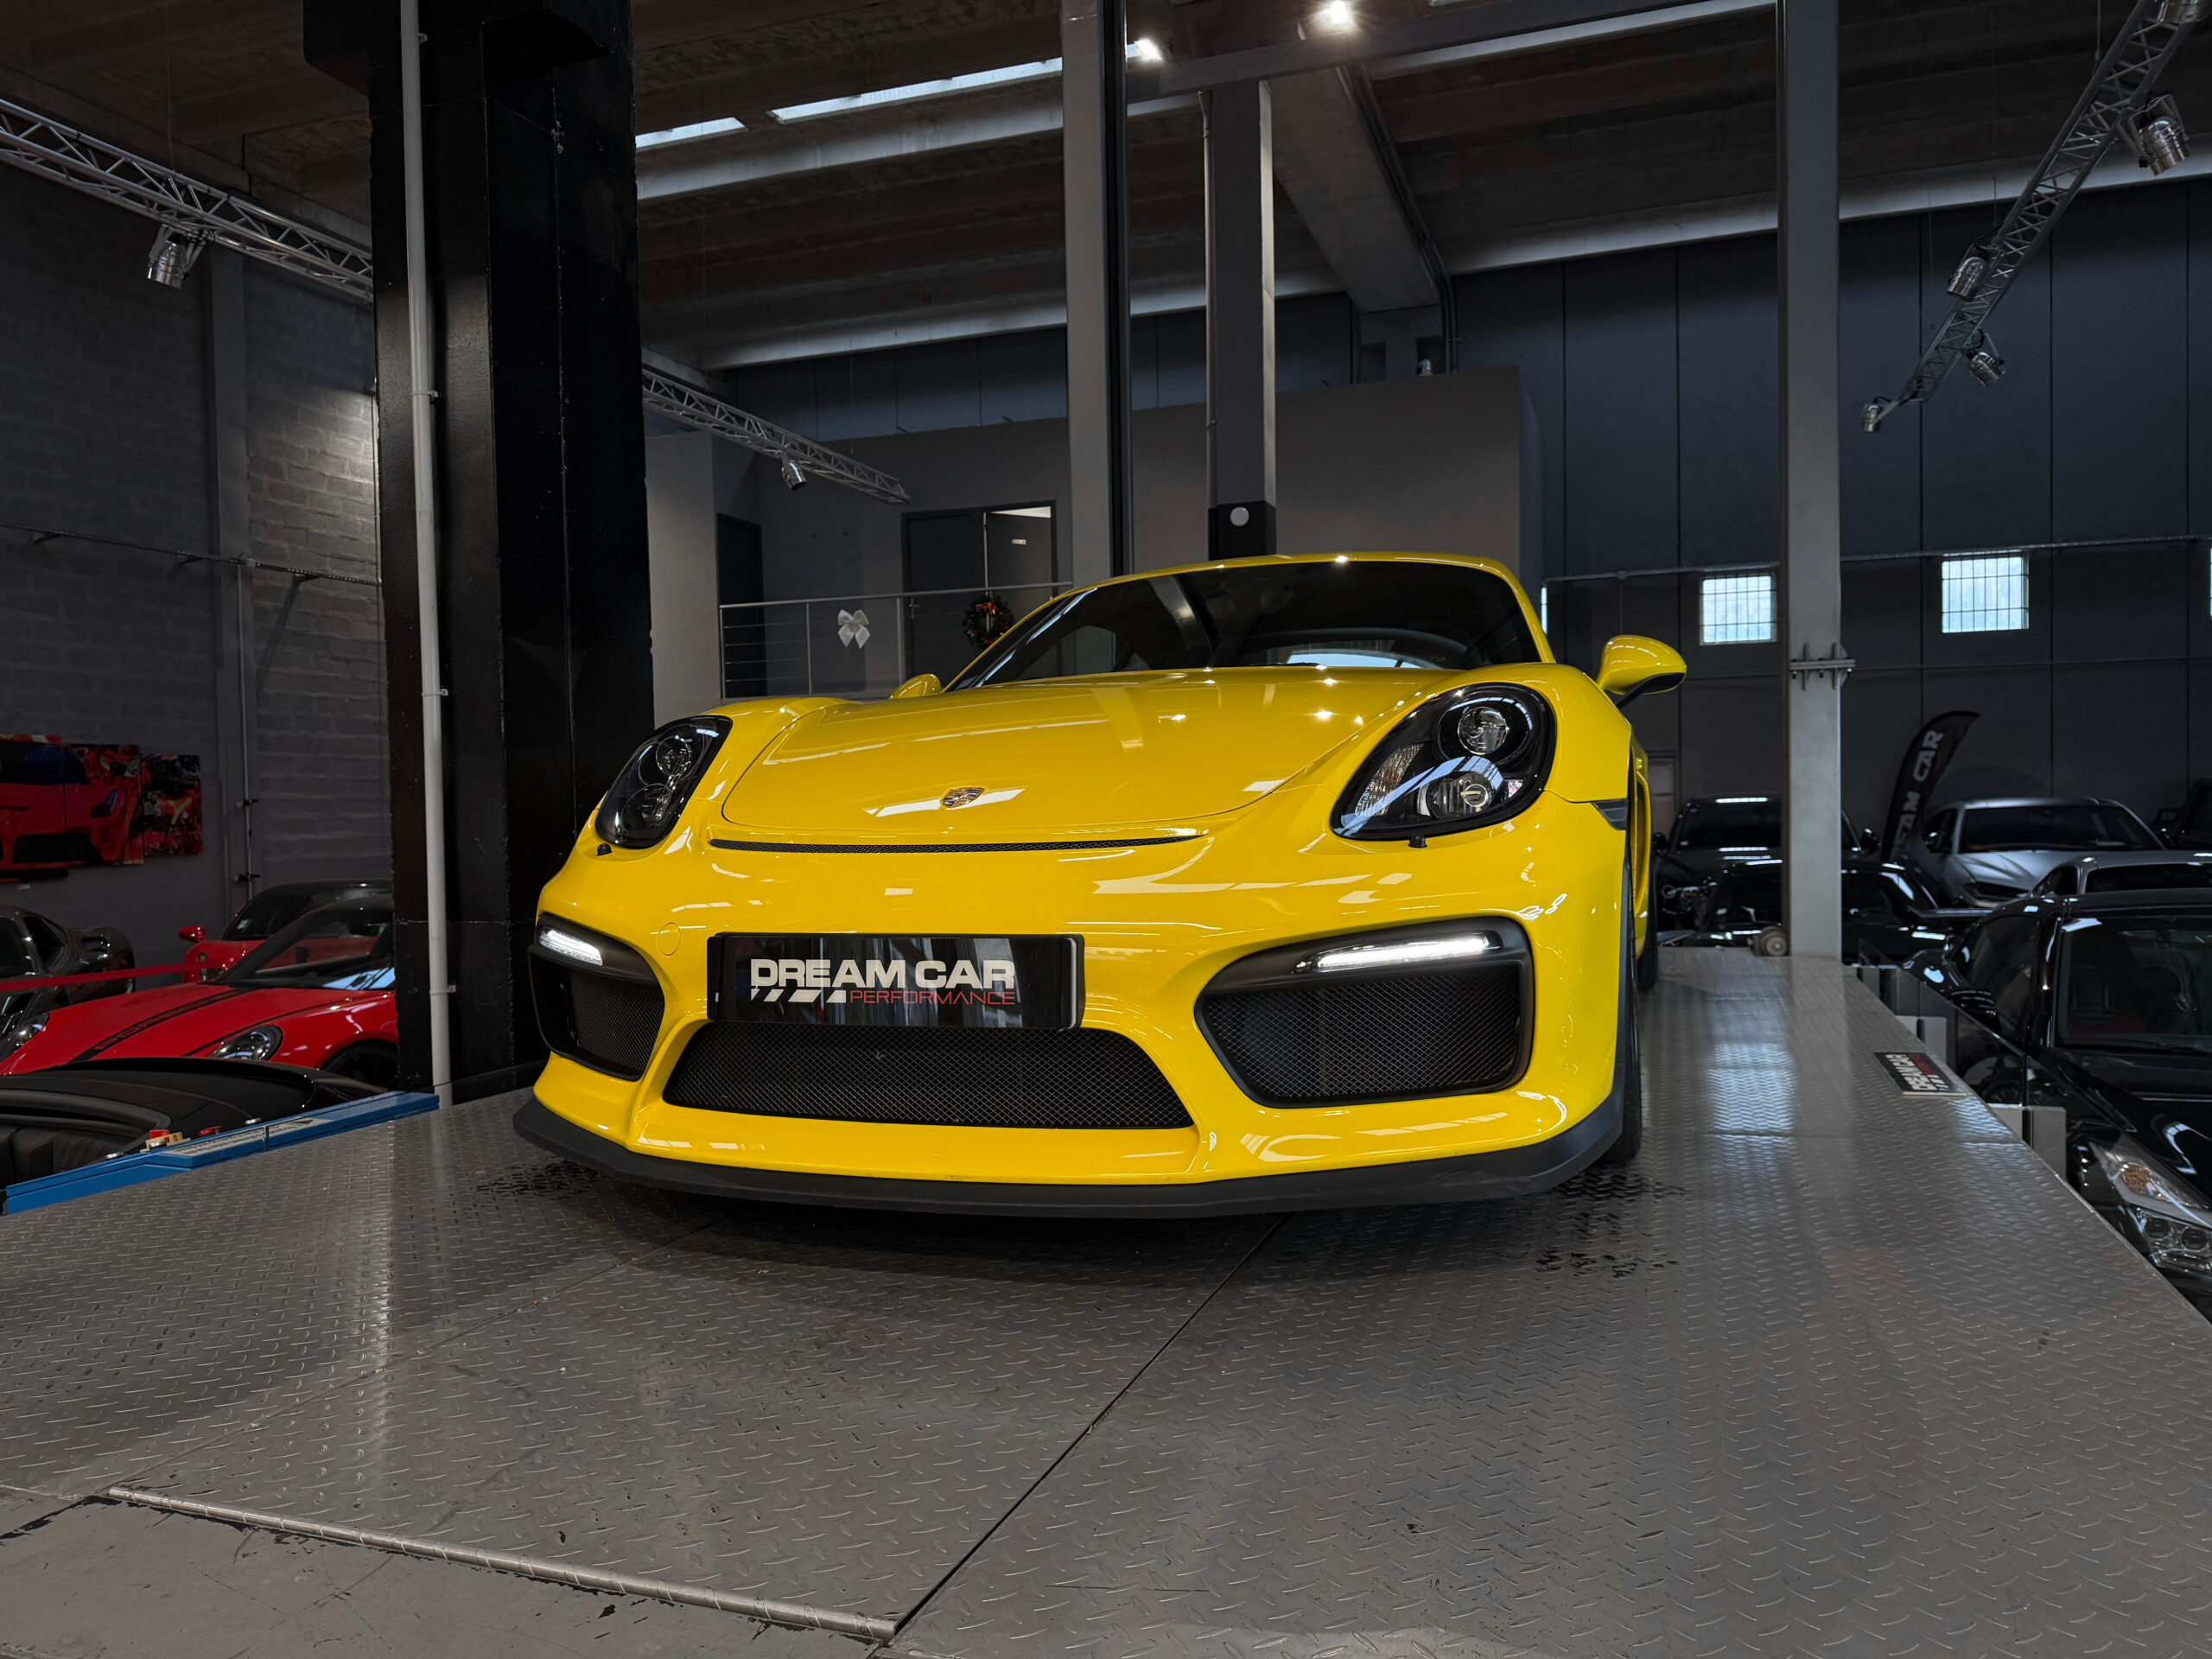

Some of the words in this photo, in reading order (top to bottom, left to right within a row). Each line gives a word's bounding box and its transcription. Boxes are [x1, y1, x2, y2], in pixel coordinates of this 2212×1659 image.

[1913, 730, 1943, 782] CAR
[751, 959, 906, 988] DREAM
[914, 960, 1015, 989] CAR
[850, 989, 1015, 1005] PERFORMANCE
